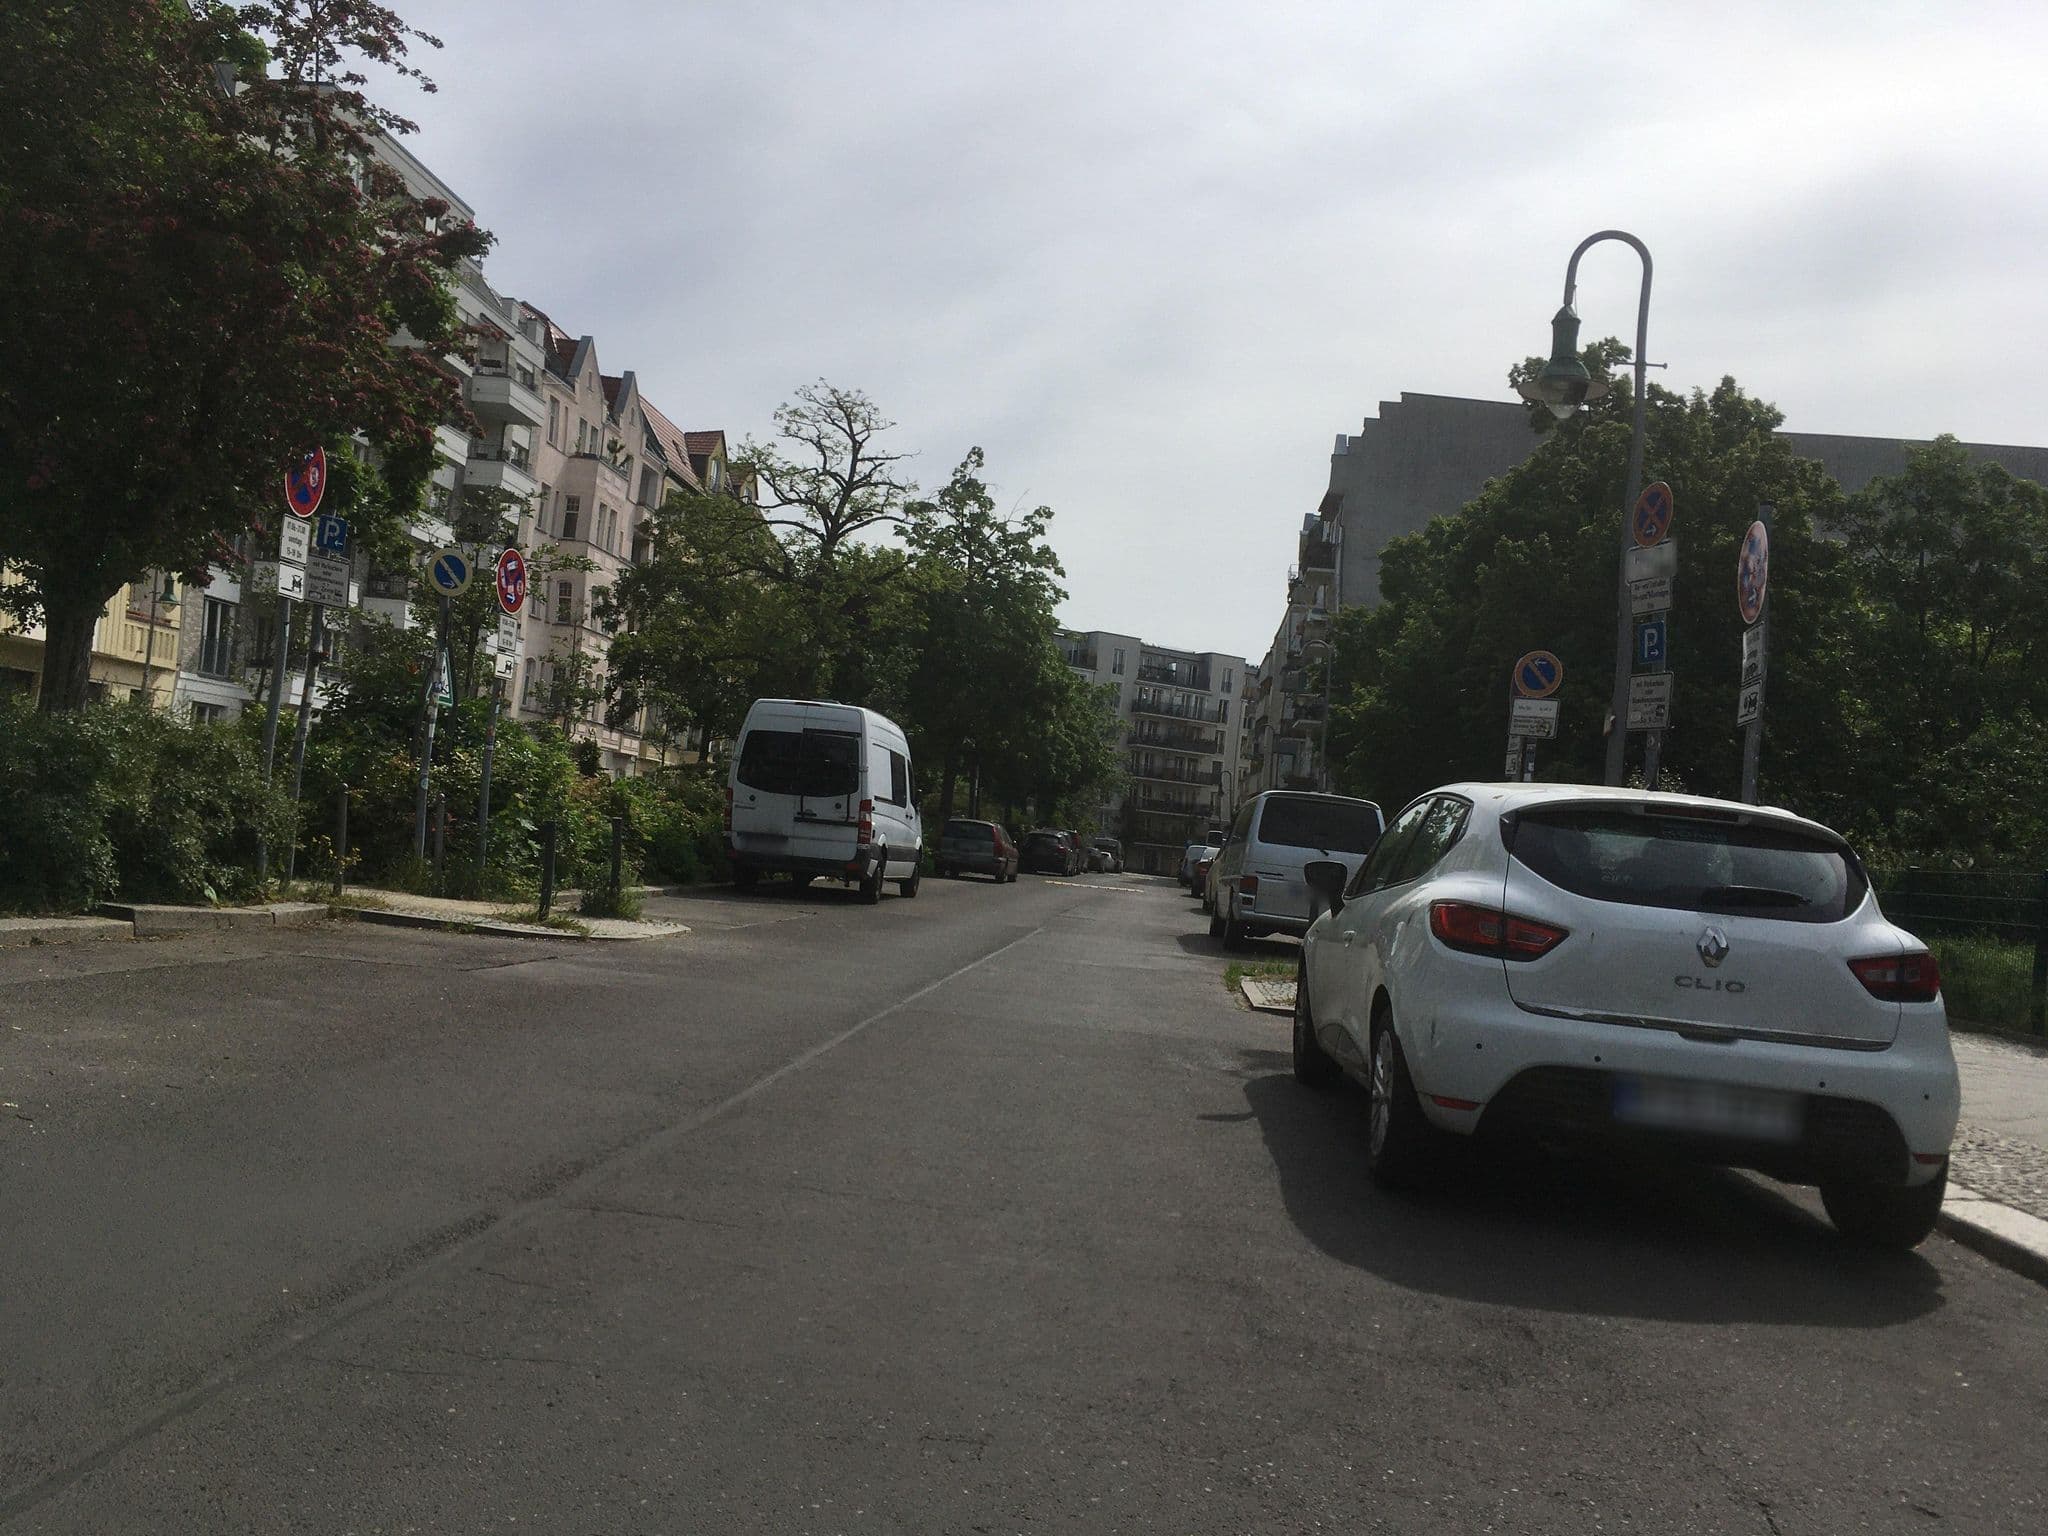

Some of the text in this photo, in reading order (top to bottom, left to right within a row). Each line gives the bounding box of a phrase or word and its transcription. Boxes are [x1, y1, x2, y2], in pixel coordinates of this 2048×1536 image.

[324, 520, 340, 545] P
[1644, 628, 1657, 658] P
[1675, 976, 1745, 992] CLIO
